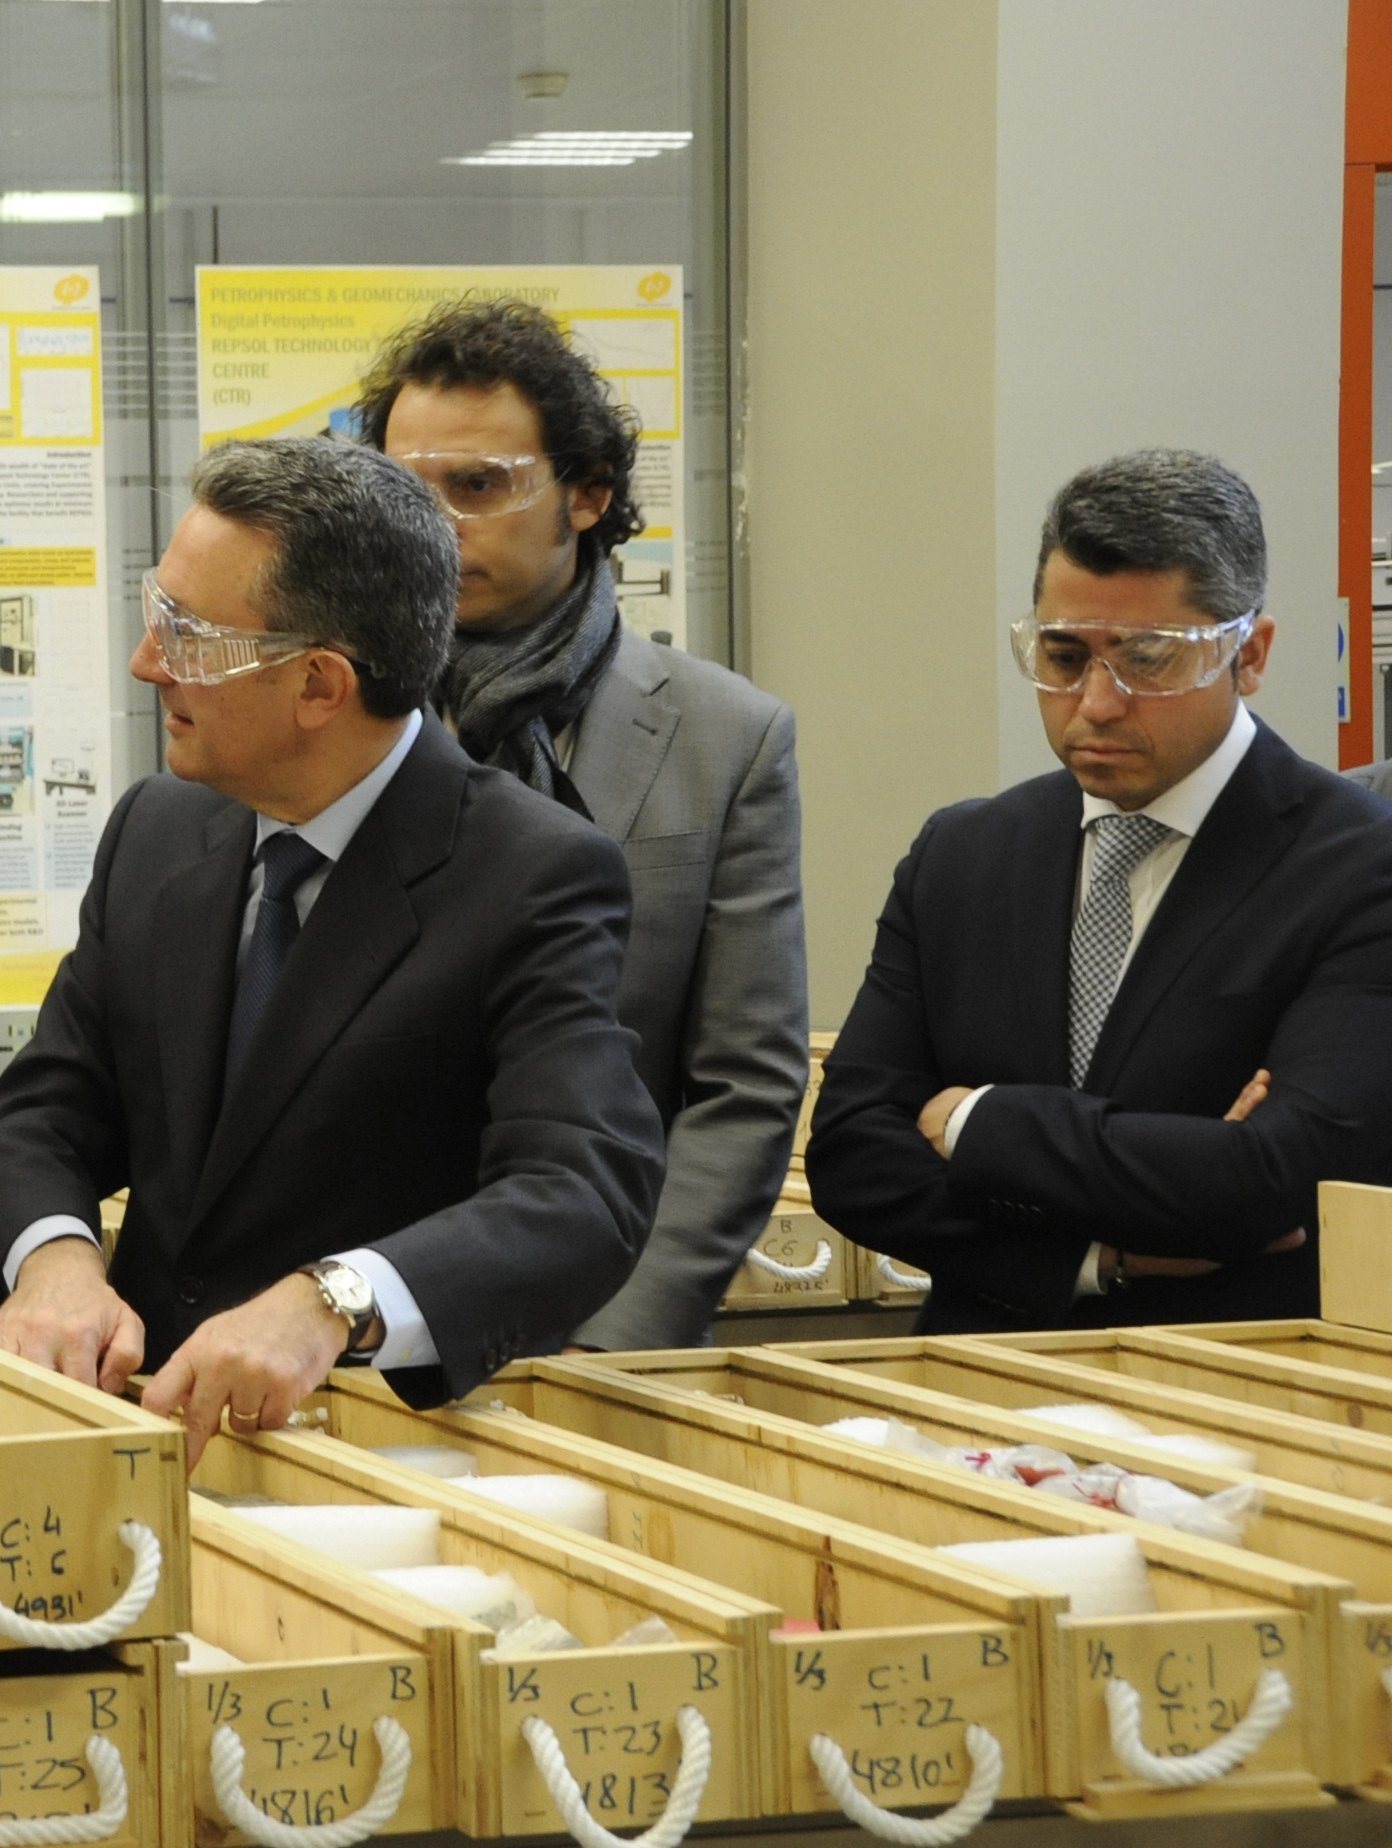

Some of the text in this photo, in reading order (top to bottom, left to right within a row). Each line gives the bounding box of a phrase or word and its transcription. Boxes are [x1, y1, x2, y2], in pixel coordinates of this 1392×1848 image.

[211, 287, 559, 304] PETROPHYSICS & GEOMECHANICS LABORATORY
[211, 314, 355, 333] Digital Petrophysics
[211, 338, 371, 354] REPSOL TECHNOLOGY
[212, 362, 270, 379] CENTRE
[212, 388, 251, 406] (CTR)
[112, 1447, 151, 1480] T
[979, 1633, 1010, 1667] B
[1254, 1622, 1286, 1659] B
[389, 1665, 417, 1701] B
[508, 1666, 541, 1703] 1/3
[691, 1652, 720, 1692] B
[794, 1651, 827, 1691] 1/3
[87, 1687, 118, 1730] B
[208, 1681, 243, 1725] 1/3
